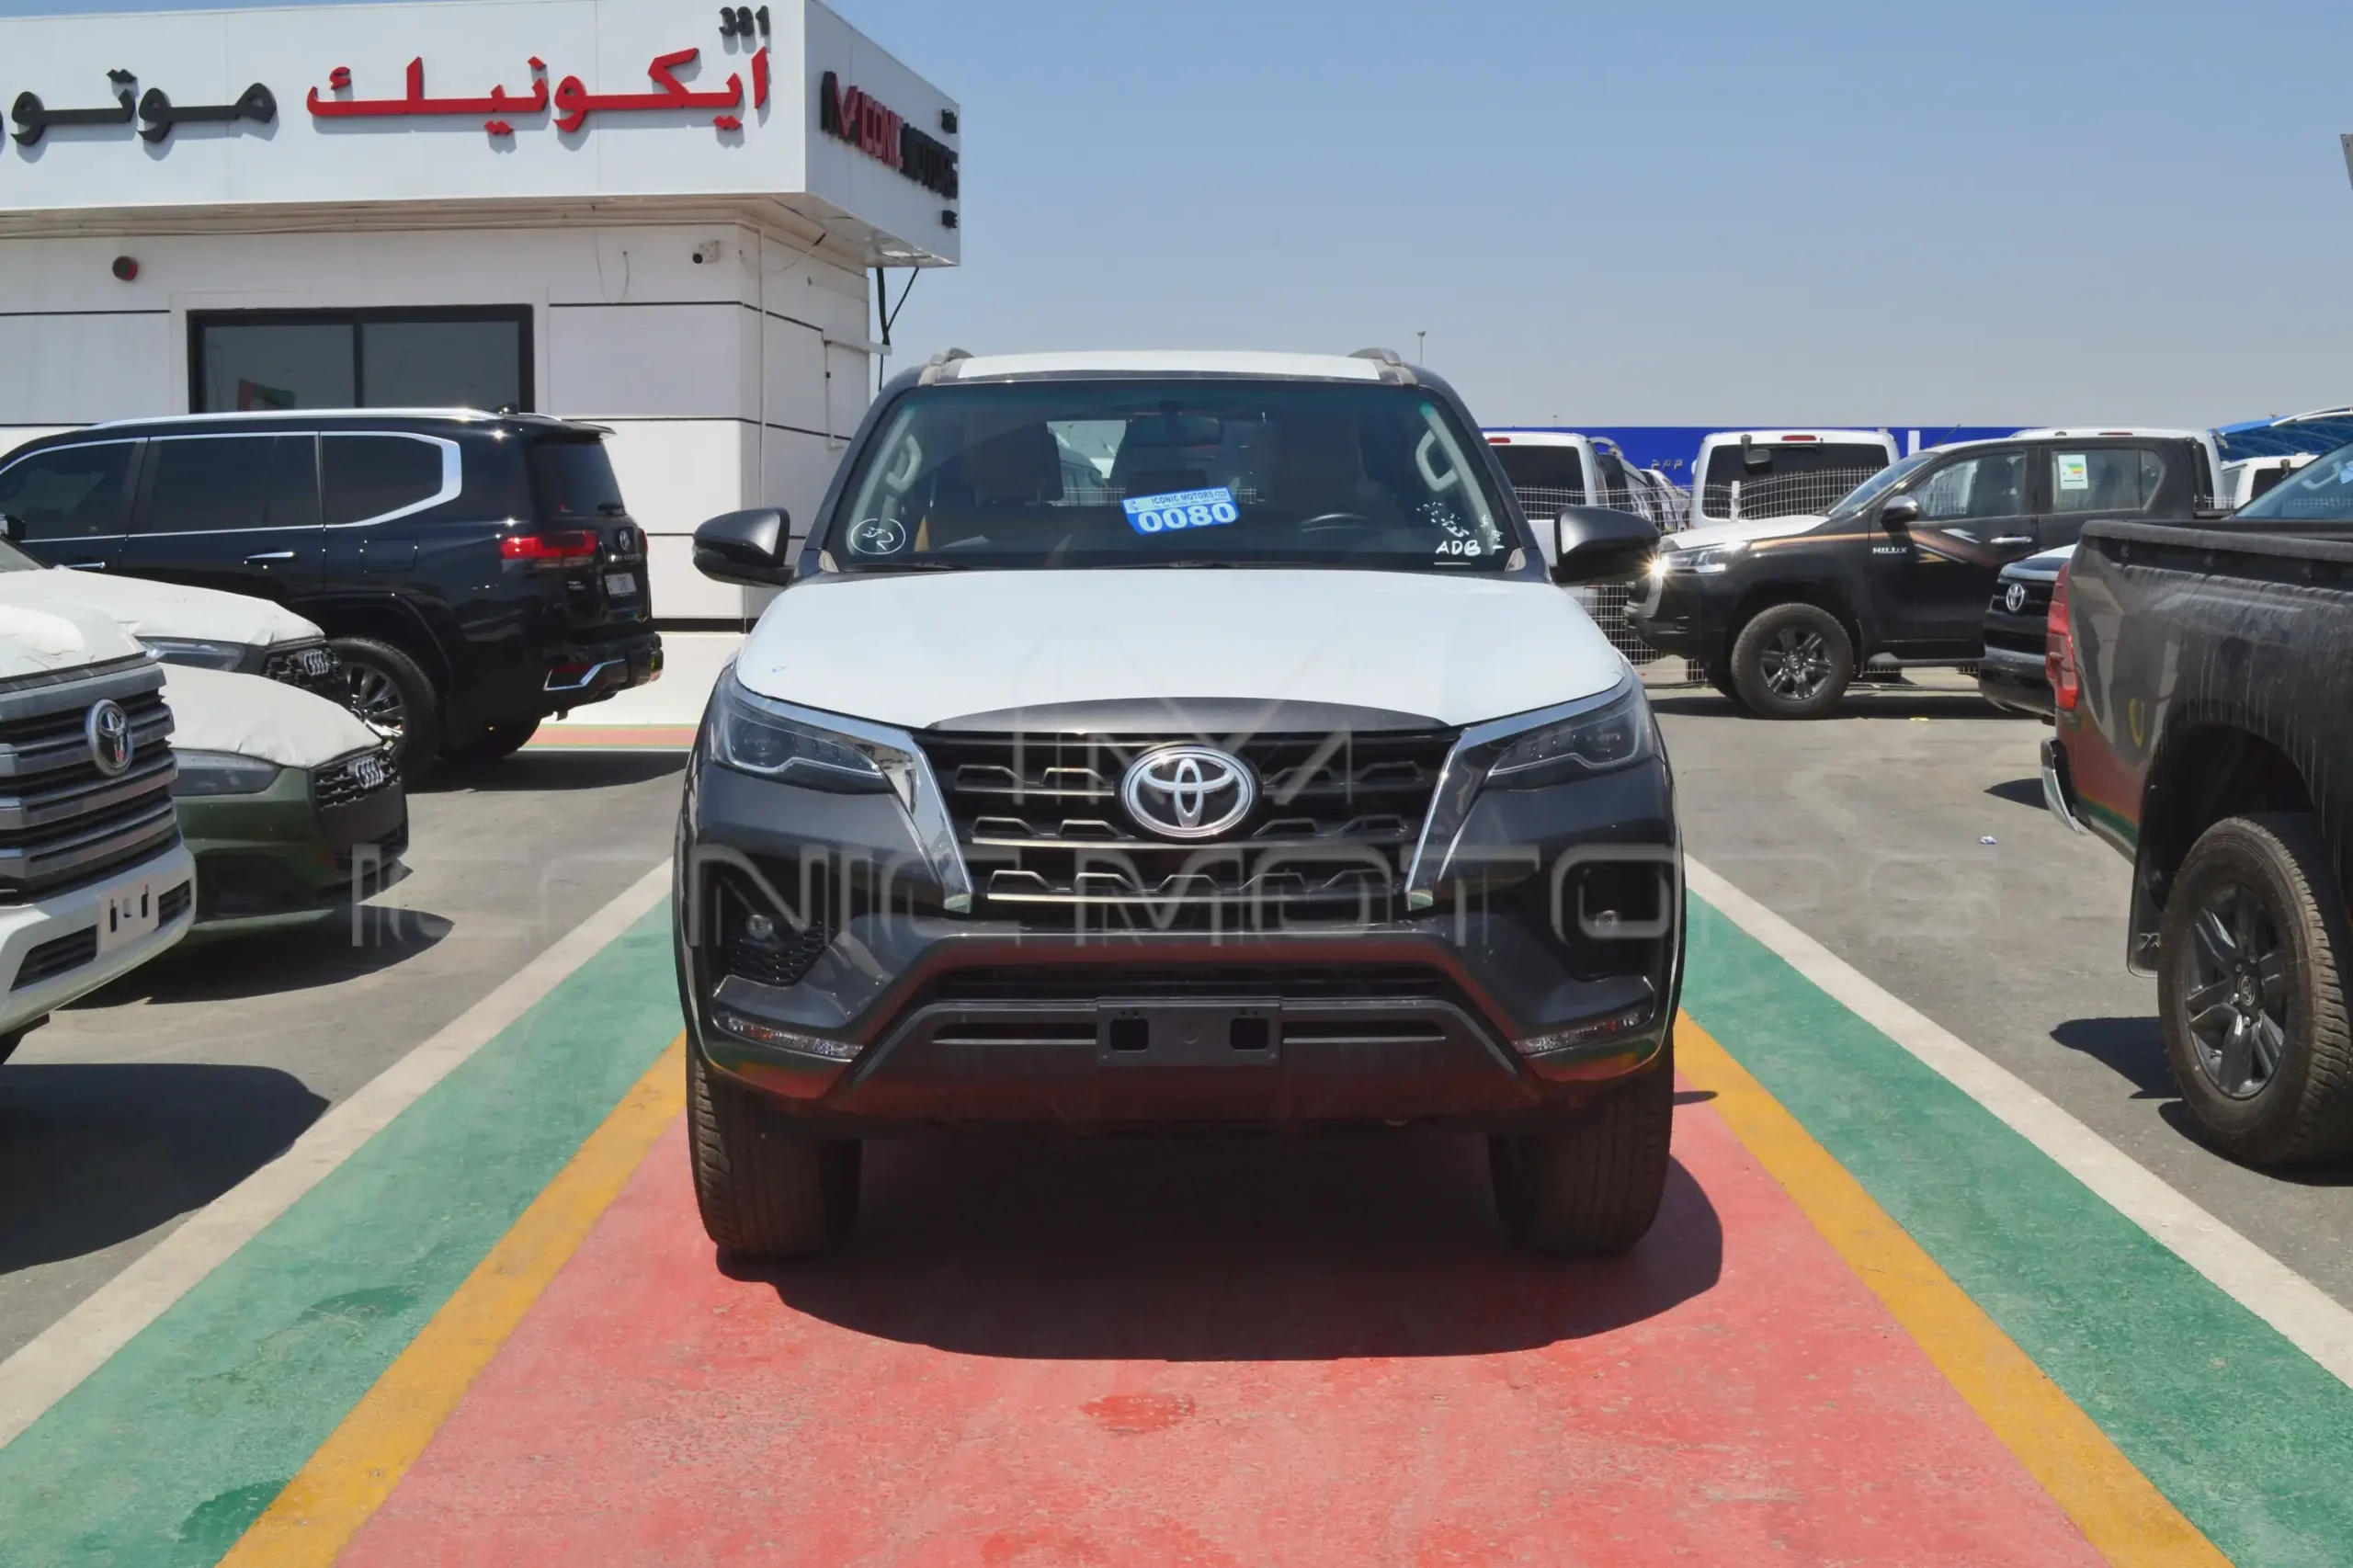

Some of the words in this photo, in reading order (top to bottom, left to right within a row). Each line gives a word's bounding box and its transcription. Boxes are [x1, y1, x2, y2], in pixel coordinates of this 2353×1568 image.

[0, 69, 277, 146] موتو
[1151, 495, 1179, 505] ICONIC
[1180, 491, 1214, 502] MOTORS
[1138, 502, 1237, 532] 0080
[1872, 546, 1908, 555] HILUX
